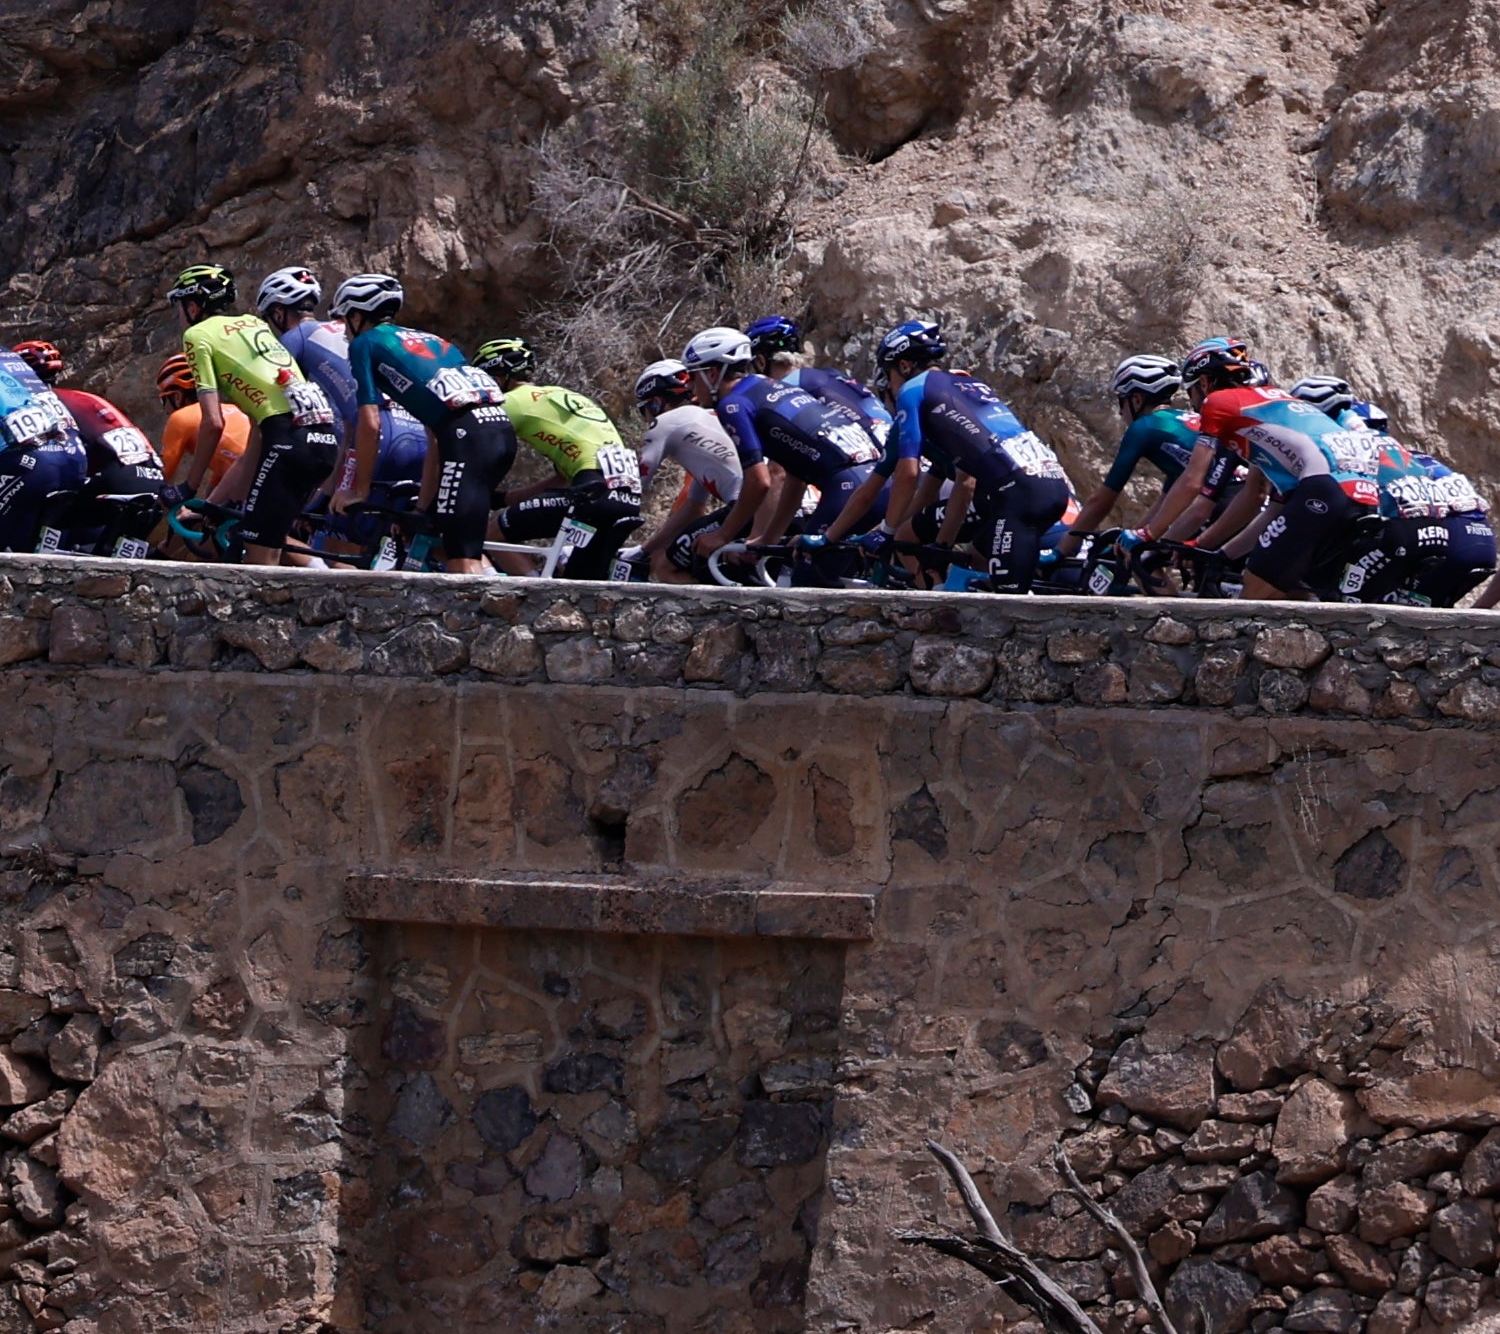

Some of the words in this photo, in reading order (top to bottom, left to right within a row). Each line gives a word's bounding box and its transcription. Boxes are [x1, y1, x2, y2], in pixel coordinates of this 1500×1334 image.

[221, 371, 269, 408] ARKEA
[435, 374, 471, 398] 201
[945, 408, 981, 436] FACTOR
[306, 431, 338, 445] ARKEA
[533, 430, 583, 463] ARKEA
[682, 430, 737, 461] FACTOR
[769, 426, 821, 462] Groupama
[1264, 434, 1296, 463] SOLAR
[136, 466, 164, 480] INEOS
[257, 450, 280, 490] HOTELS
[340, 455, 358, 492] pecin
[604, 452, 625, 477] 15
[1208, 456, 1228, 486] BORA
[436, 460, 457, 515] KERN
[542, 496, 570, 508] HOTE
[42, 528, 60, 551] 197
[567, 529, 588, 546] 201
[991, 518, 1006, 556] PREMIER
[1000, 531, 1013, 554] TECH
[1257, 515, 1287, 549] Lotto
[118, 542, 135, 559] 06
[614, 563, 630, 581] 55
[1347, 571, 1361, 589] 93
